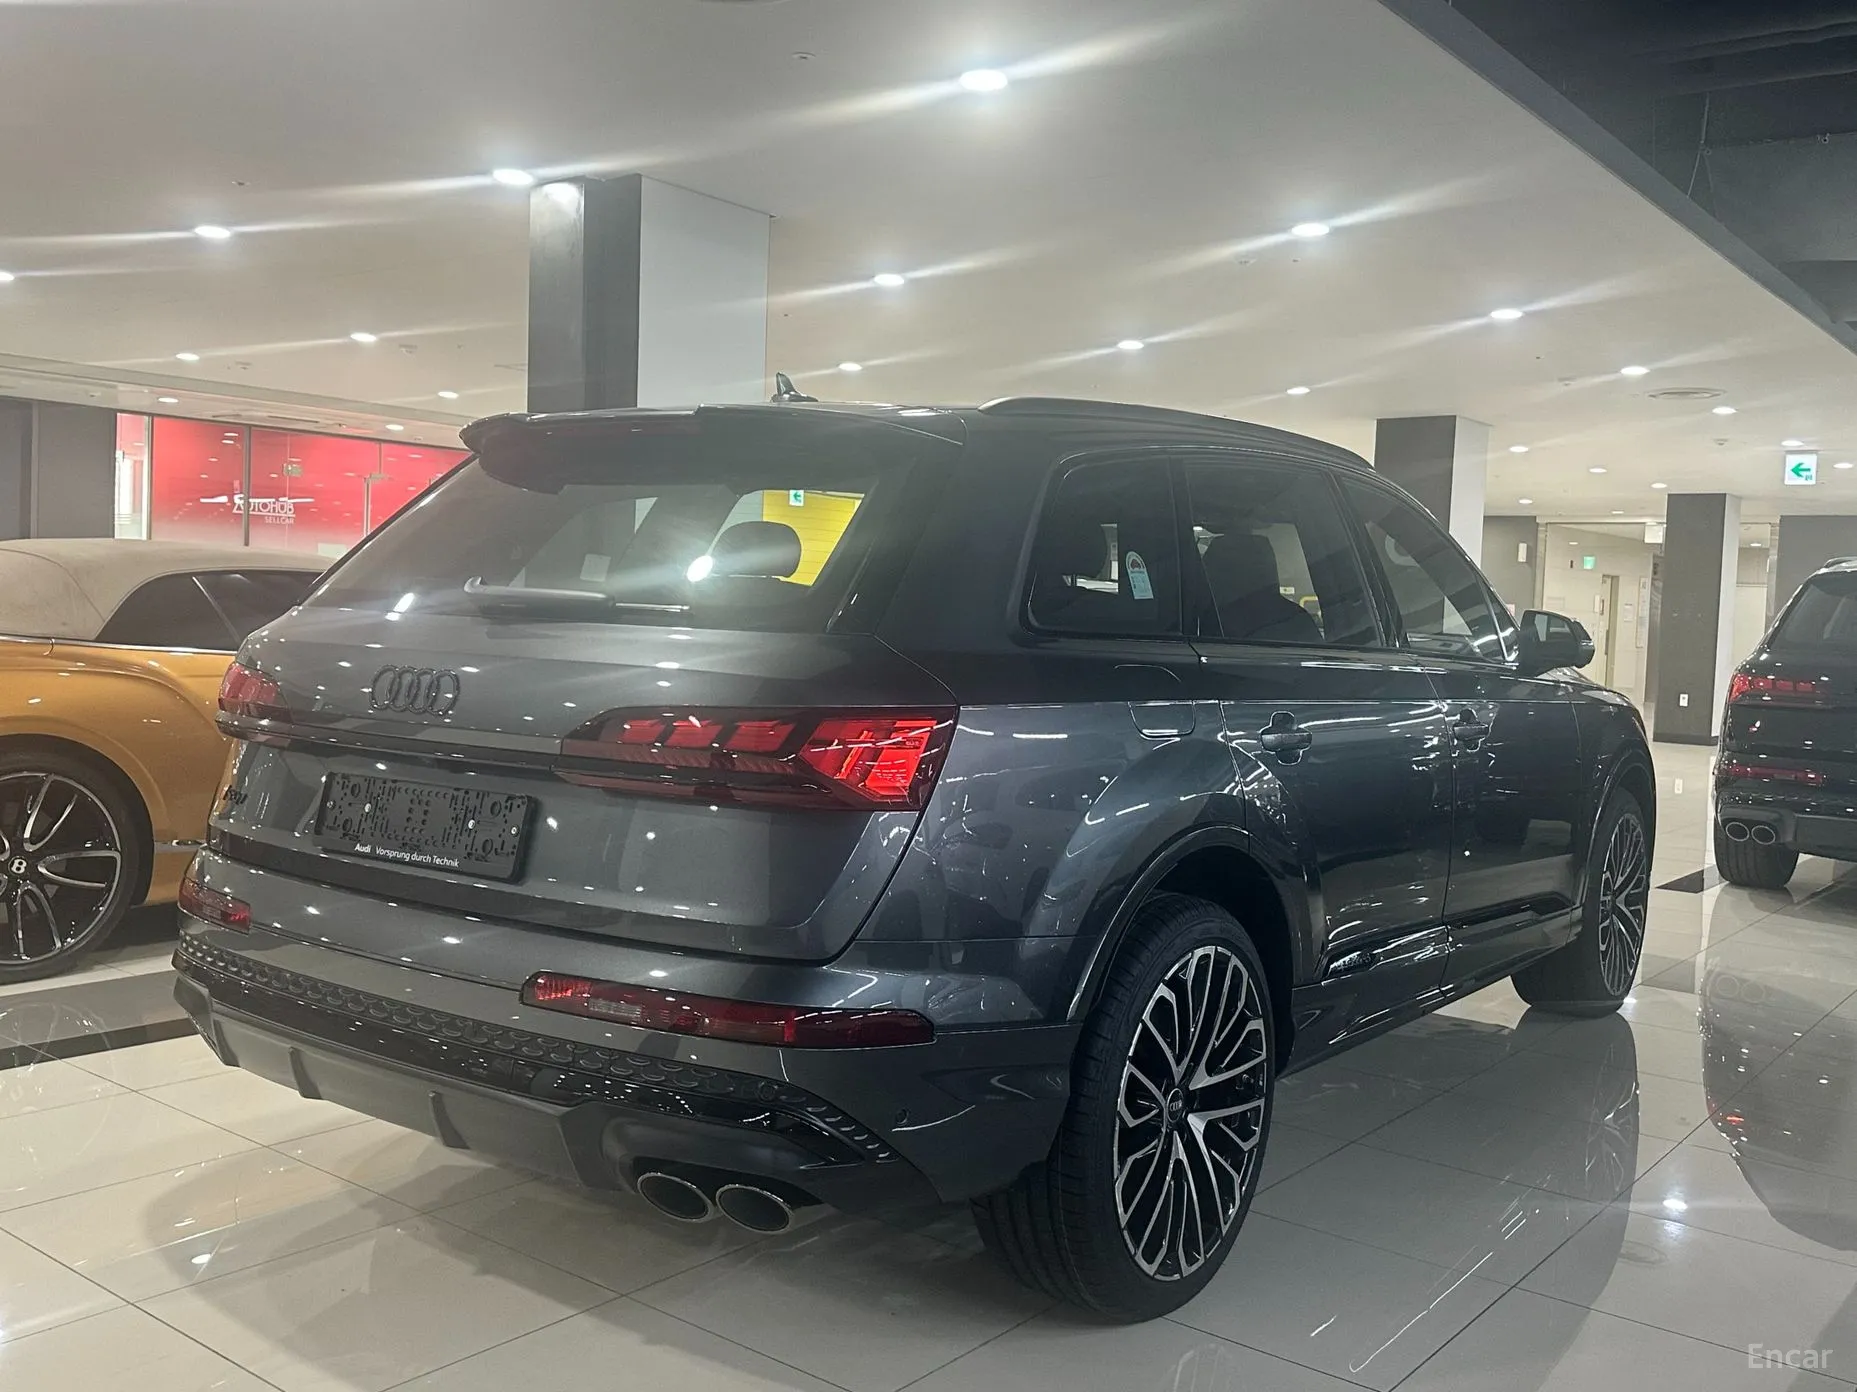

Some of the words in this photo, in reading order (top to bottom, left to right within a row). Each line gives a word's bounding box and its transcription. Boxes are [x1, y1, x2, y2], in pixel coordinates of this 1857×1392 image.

[264, 516, 295, 525] SELLCAR
[354, 843, 371, 853] Audi
[375, 846, 411, 861] Vorsprung
[411, 852, 431, 863] durch
[432, 855, 460, 867] Technik
